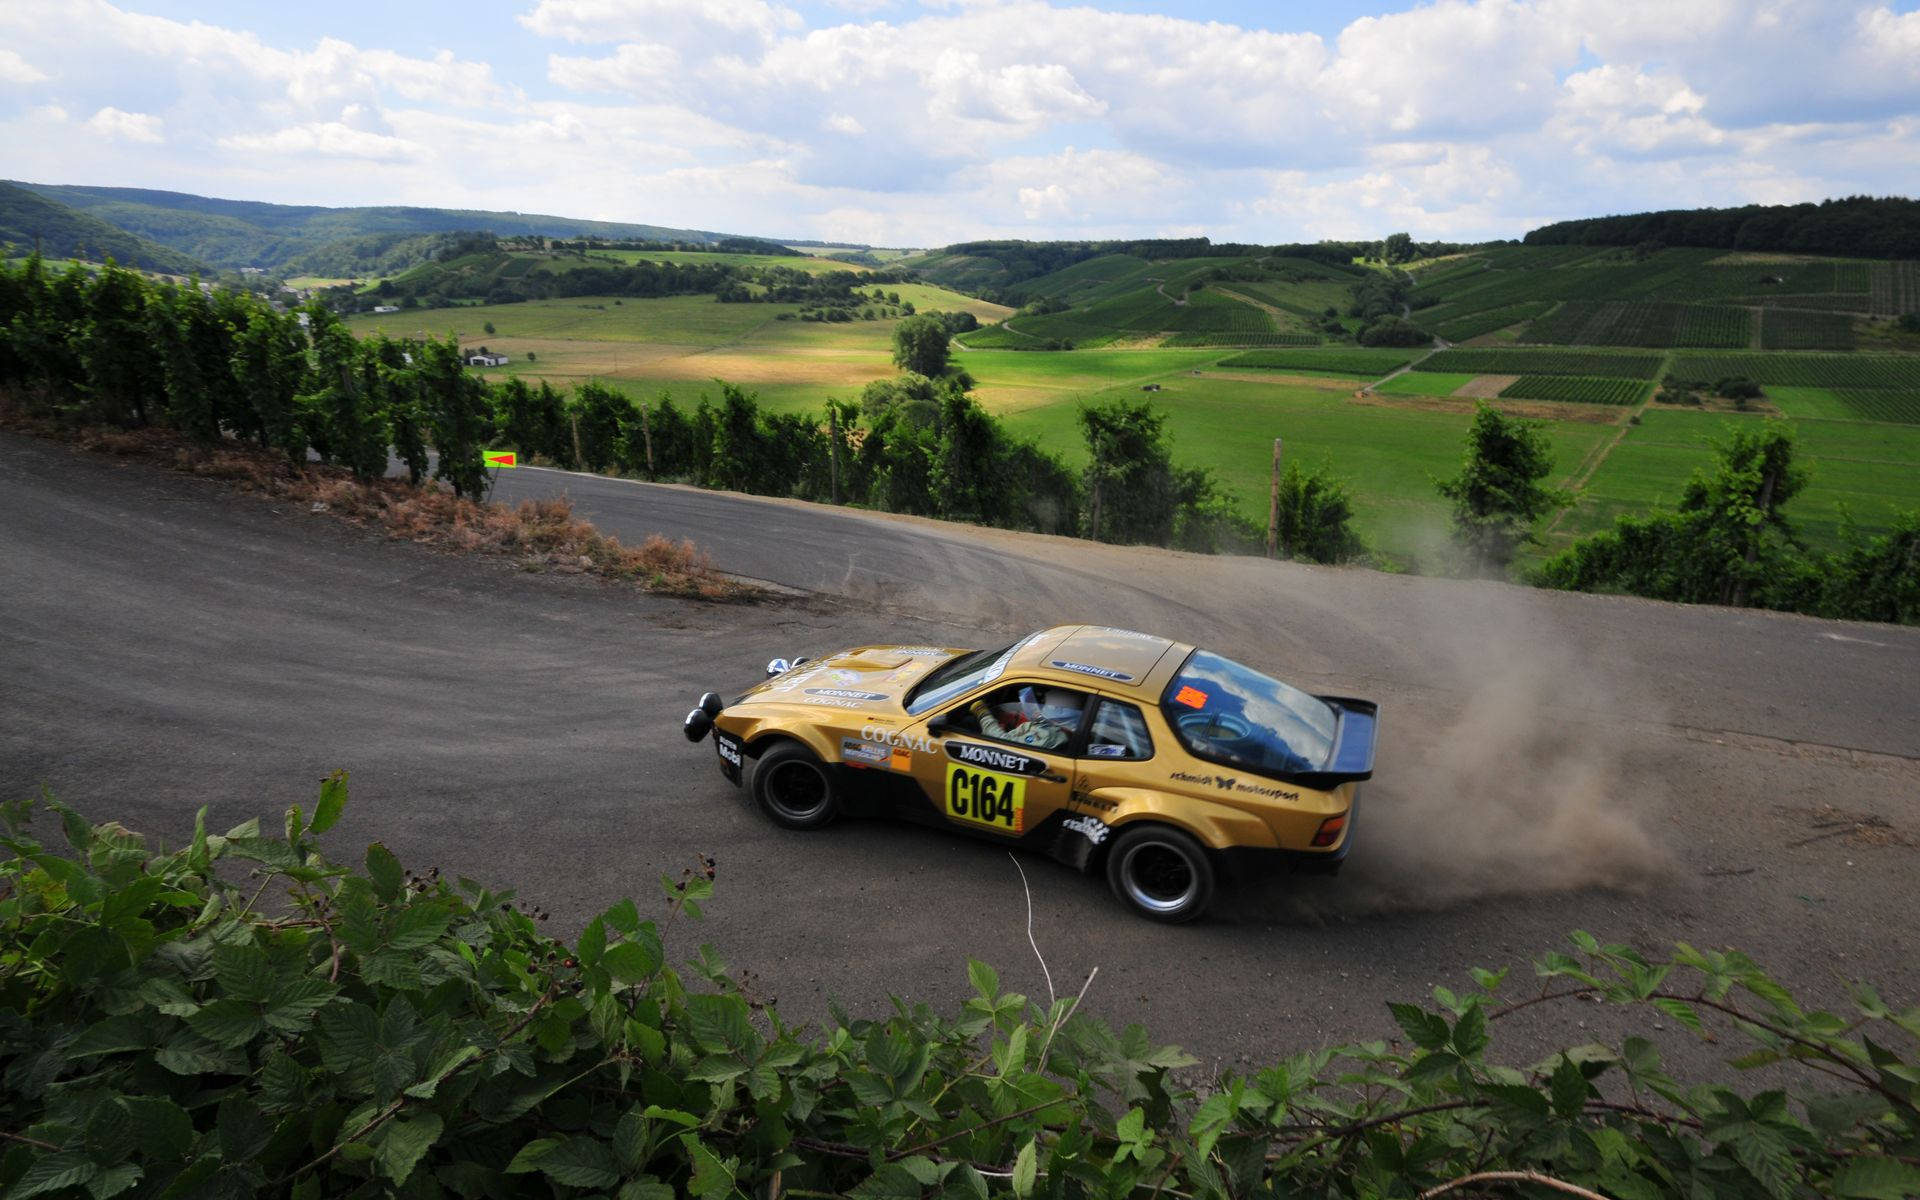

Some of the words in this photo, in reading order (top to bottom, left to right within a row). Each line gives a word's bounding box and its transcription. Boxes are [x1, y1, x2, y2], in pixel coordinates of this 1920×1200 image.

[1063, 662, 1120, 677] MONNET
[803, 696, 864, 708] COGNAC
[816, 688, 876, 700] MONNET
[861, 724, 938, 754] COGNAC
[959, 745, 1030, 772] MONNET
[951, 768, 1015, 826] C164
[1169, 771, 1213, 786] schmidt
[1236, 784, 1300, 802] motorsport
